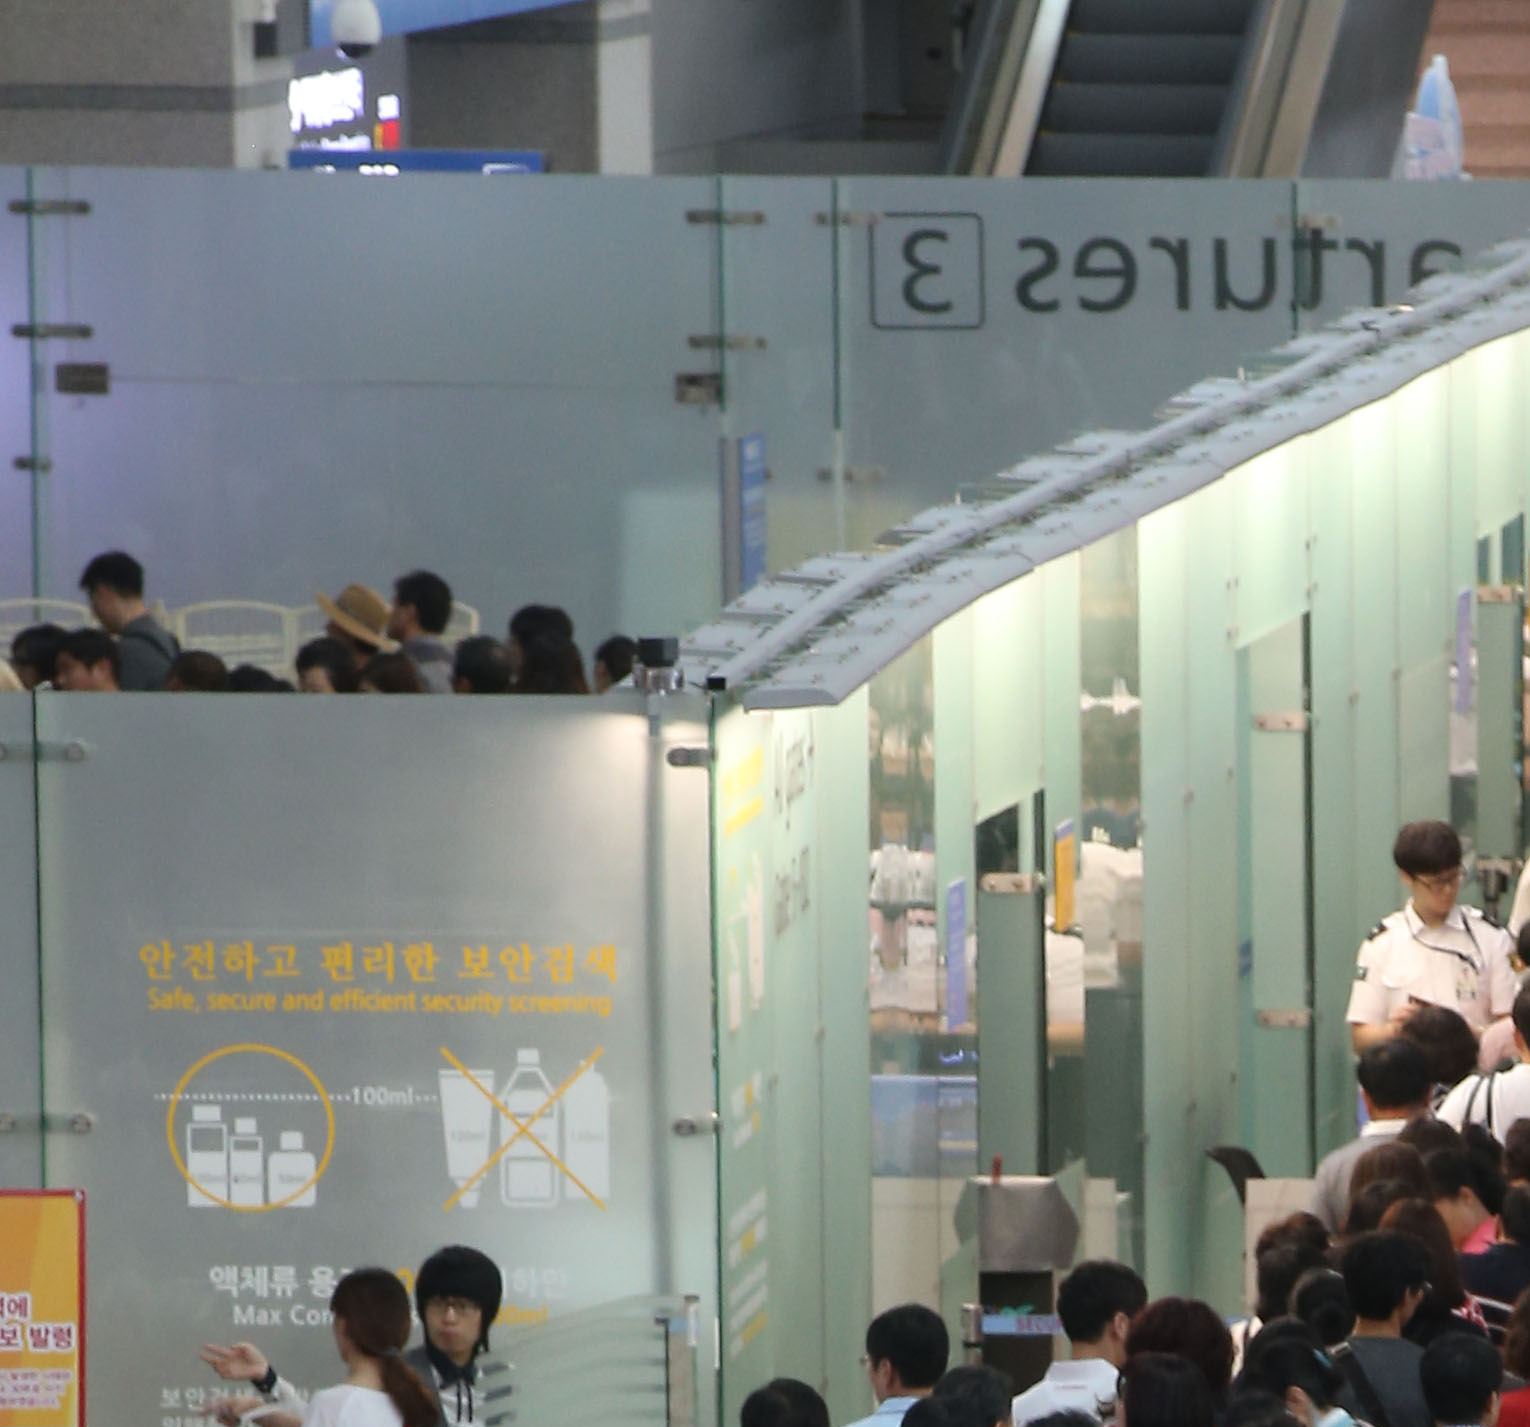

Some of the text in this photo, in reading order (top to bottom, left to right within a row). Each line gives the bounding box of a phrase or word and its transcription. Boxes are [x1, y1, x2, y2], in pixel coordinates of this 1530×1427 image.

[138, 940, 620, 985] 안전하고 편리한 보안검색
[148, 986, 613, 1018] Safe, secure and efficient security screening
[351, 1086, 413, 1107] 100ml
[209, 1264, 300, 1299] 액체류
[308, 1265, 354, 1298] 용
[232, 1304, 283, 1326] Max
[30, 1325, 72, 1349] 발령
